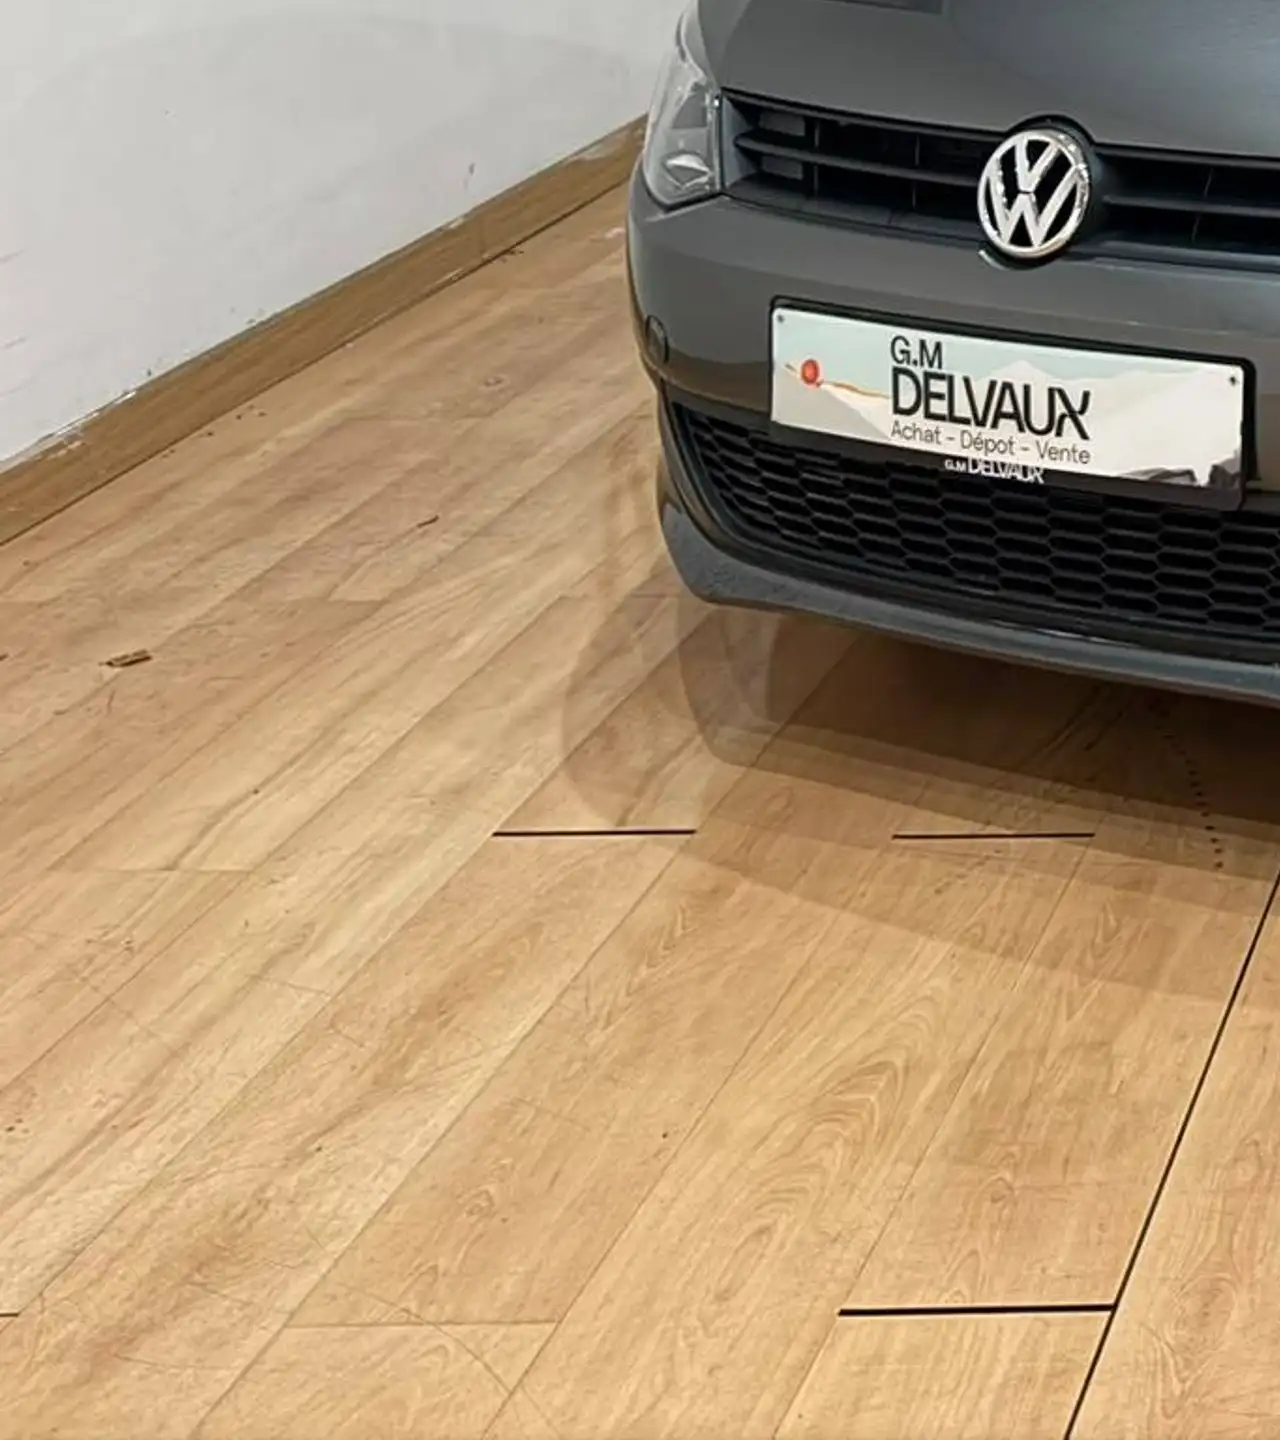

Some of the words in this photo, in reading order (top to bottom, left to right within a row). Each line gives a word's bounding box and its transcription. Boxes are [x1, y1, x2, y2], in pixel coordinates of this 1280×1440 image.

[890, 335, 943, 370] G.M
[892, 366, 1091, 440] DELVAUX
[891, 420, 942, 445] Achat
[959, 429, 1016, 457] Dépot
[1036, 440, 1091, 464] Vente
